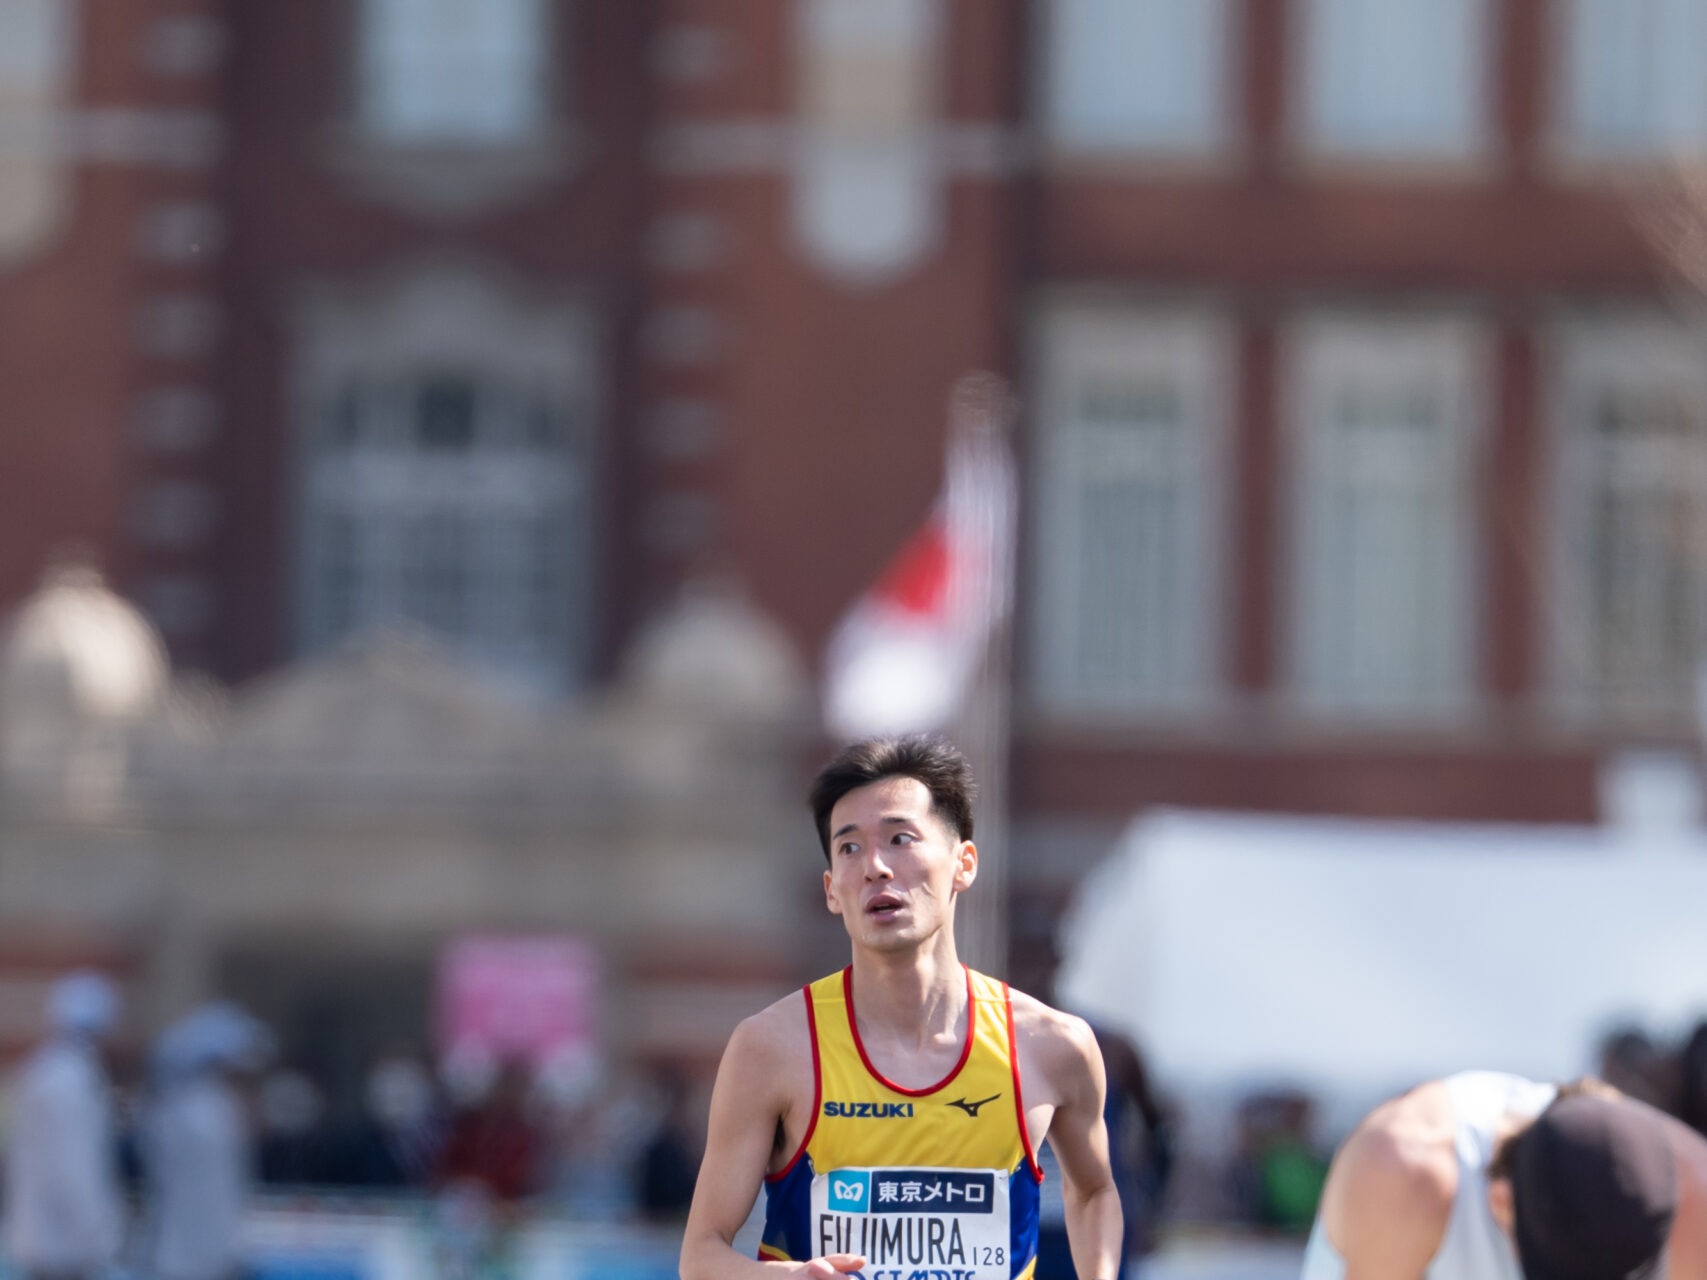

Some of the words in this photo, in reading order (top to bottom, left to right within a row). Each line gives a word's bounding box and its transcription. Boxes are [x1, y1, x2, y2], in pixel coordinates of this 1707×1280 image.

[824, 1101, 914, 1118] SUZUKI
[878, 1181, 985, 1203] 東京メトロ
[819, 1214, 966, 1266] FUJIMURA
[973, 1247, 1005, 1266] 128
